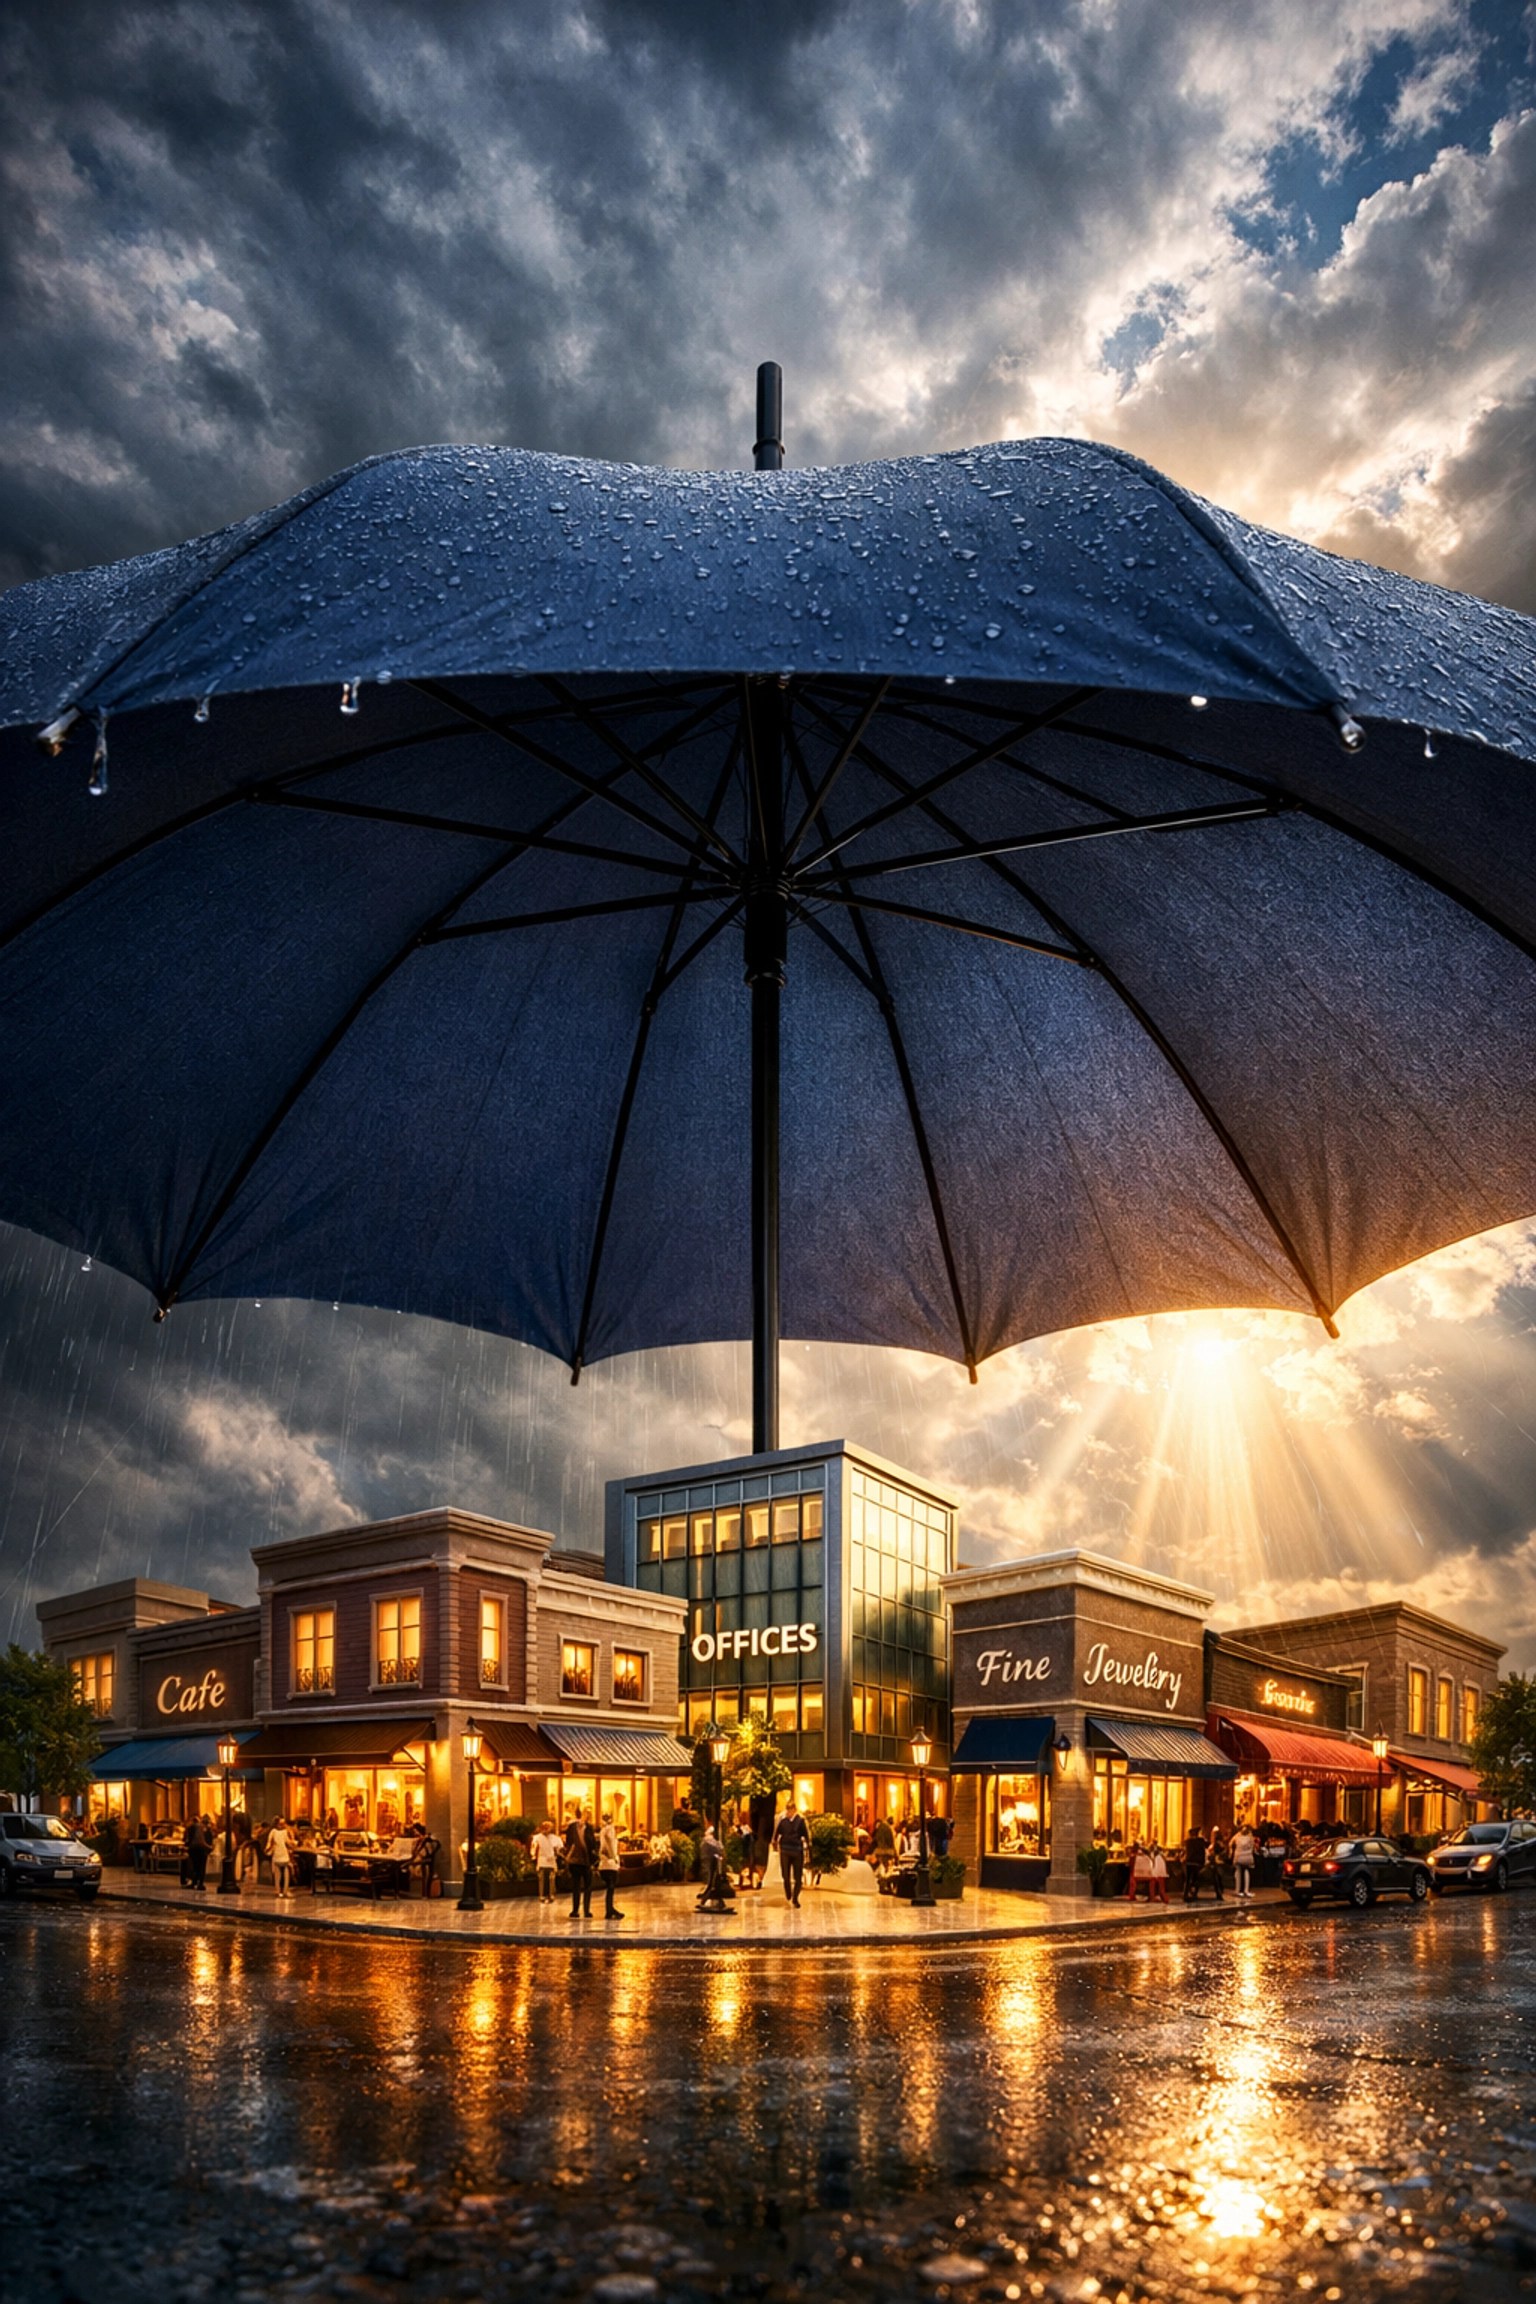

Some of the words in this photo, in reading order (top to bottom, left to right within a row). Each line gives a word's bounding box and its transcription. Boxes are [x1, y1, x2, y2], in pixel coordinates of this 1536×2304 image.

[692, 1623, 818, 1662] OFFICES
[976, 1649, 1052, 1686] Fine
[157, 1669, 225, 1714] Cafe
